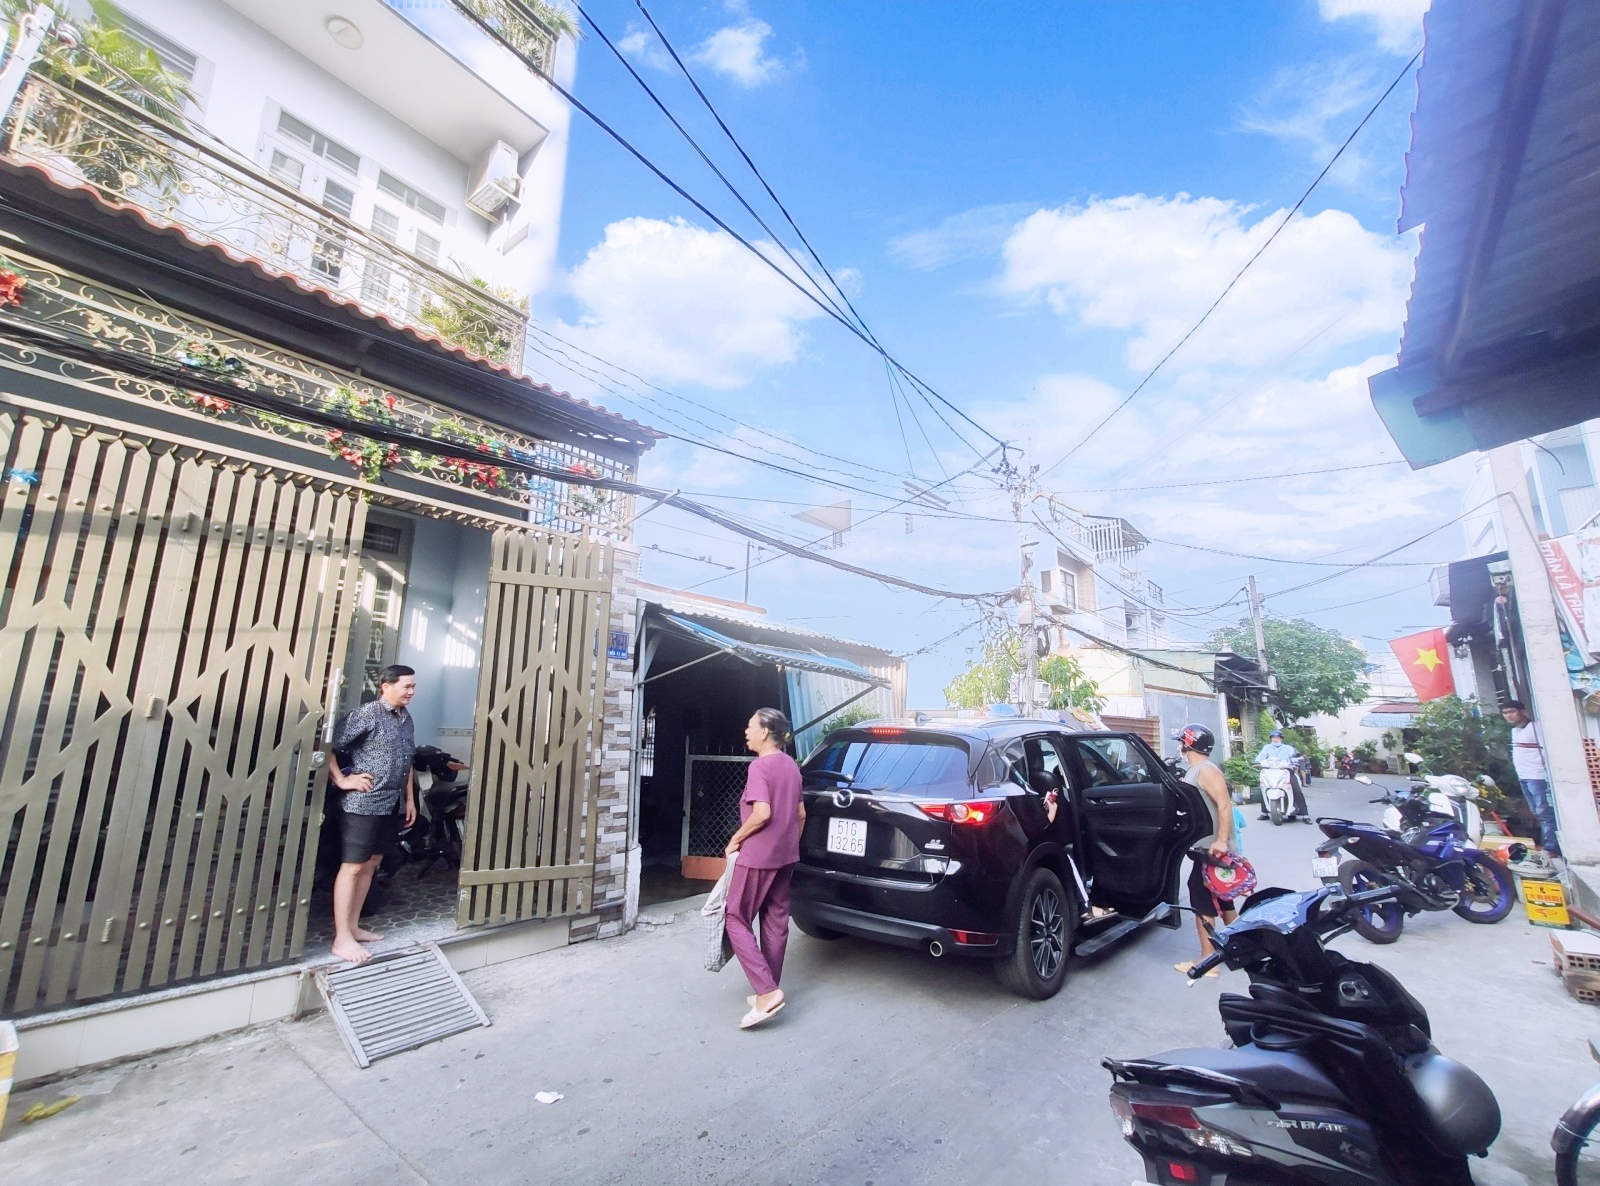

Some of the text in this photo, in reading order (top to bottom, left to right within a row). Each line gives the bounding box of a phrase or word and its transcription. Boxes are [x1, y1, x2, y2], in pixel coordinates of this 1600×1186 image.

[1554, 575, 1577, 590] LÀ
[837, 820, 858, 836] 51G
[829, 835, 864, 854] 132.65
